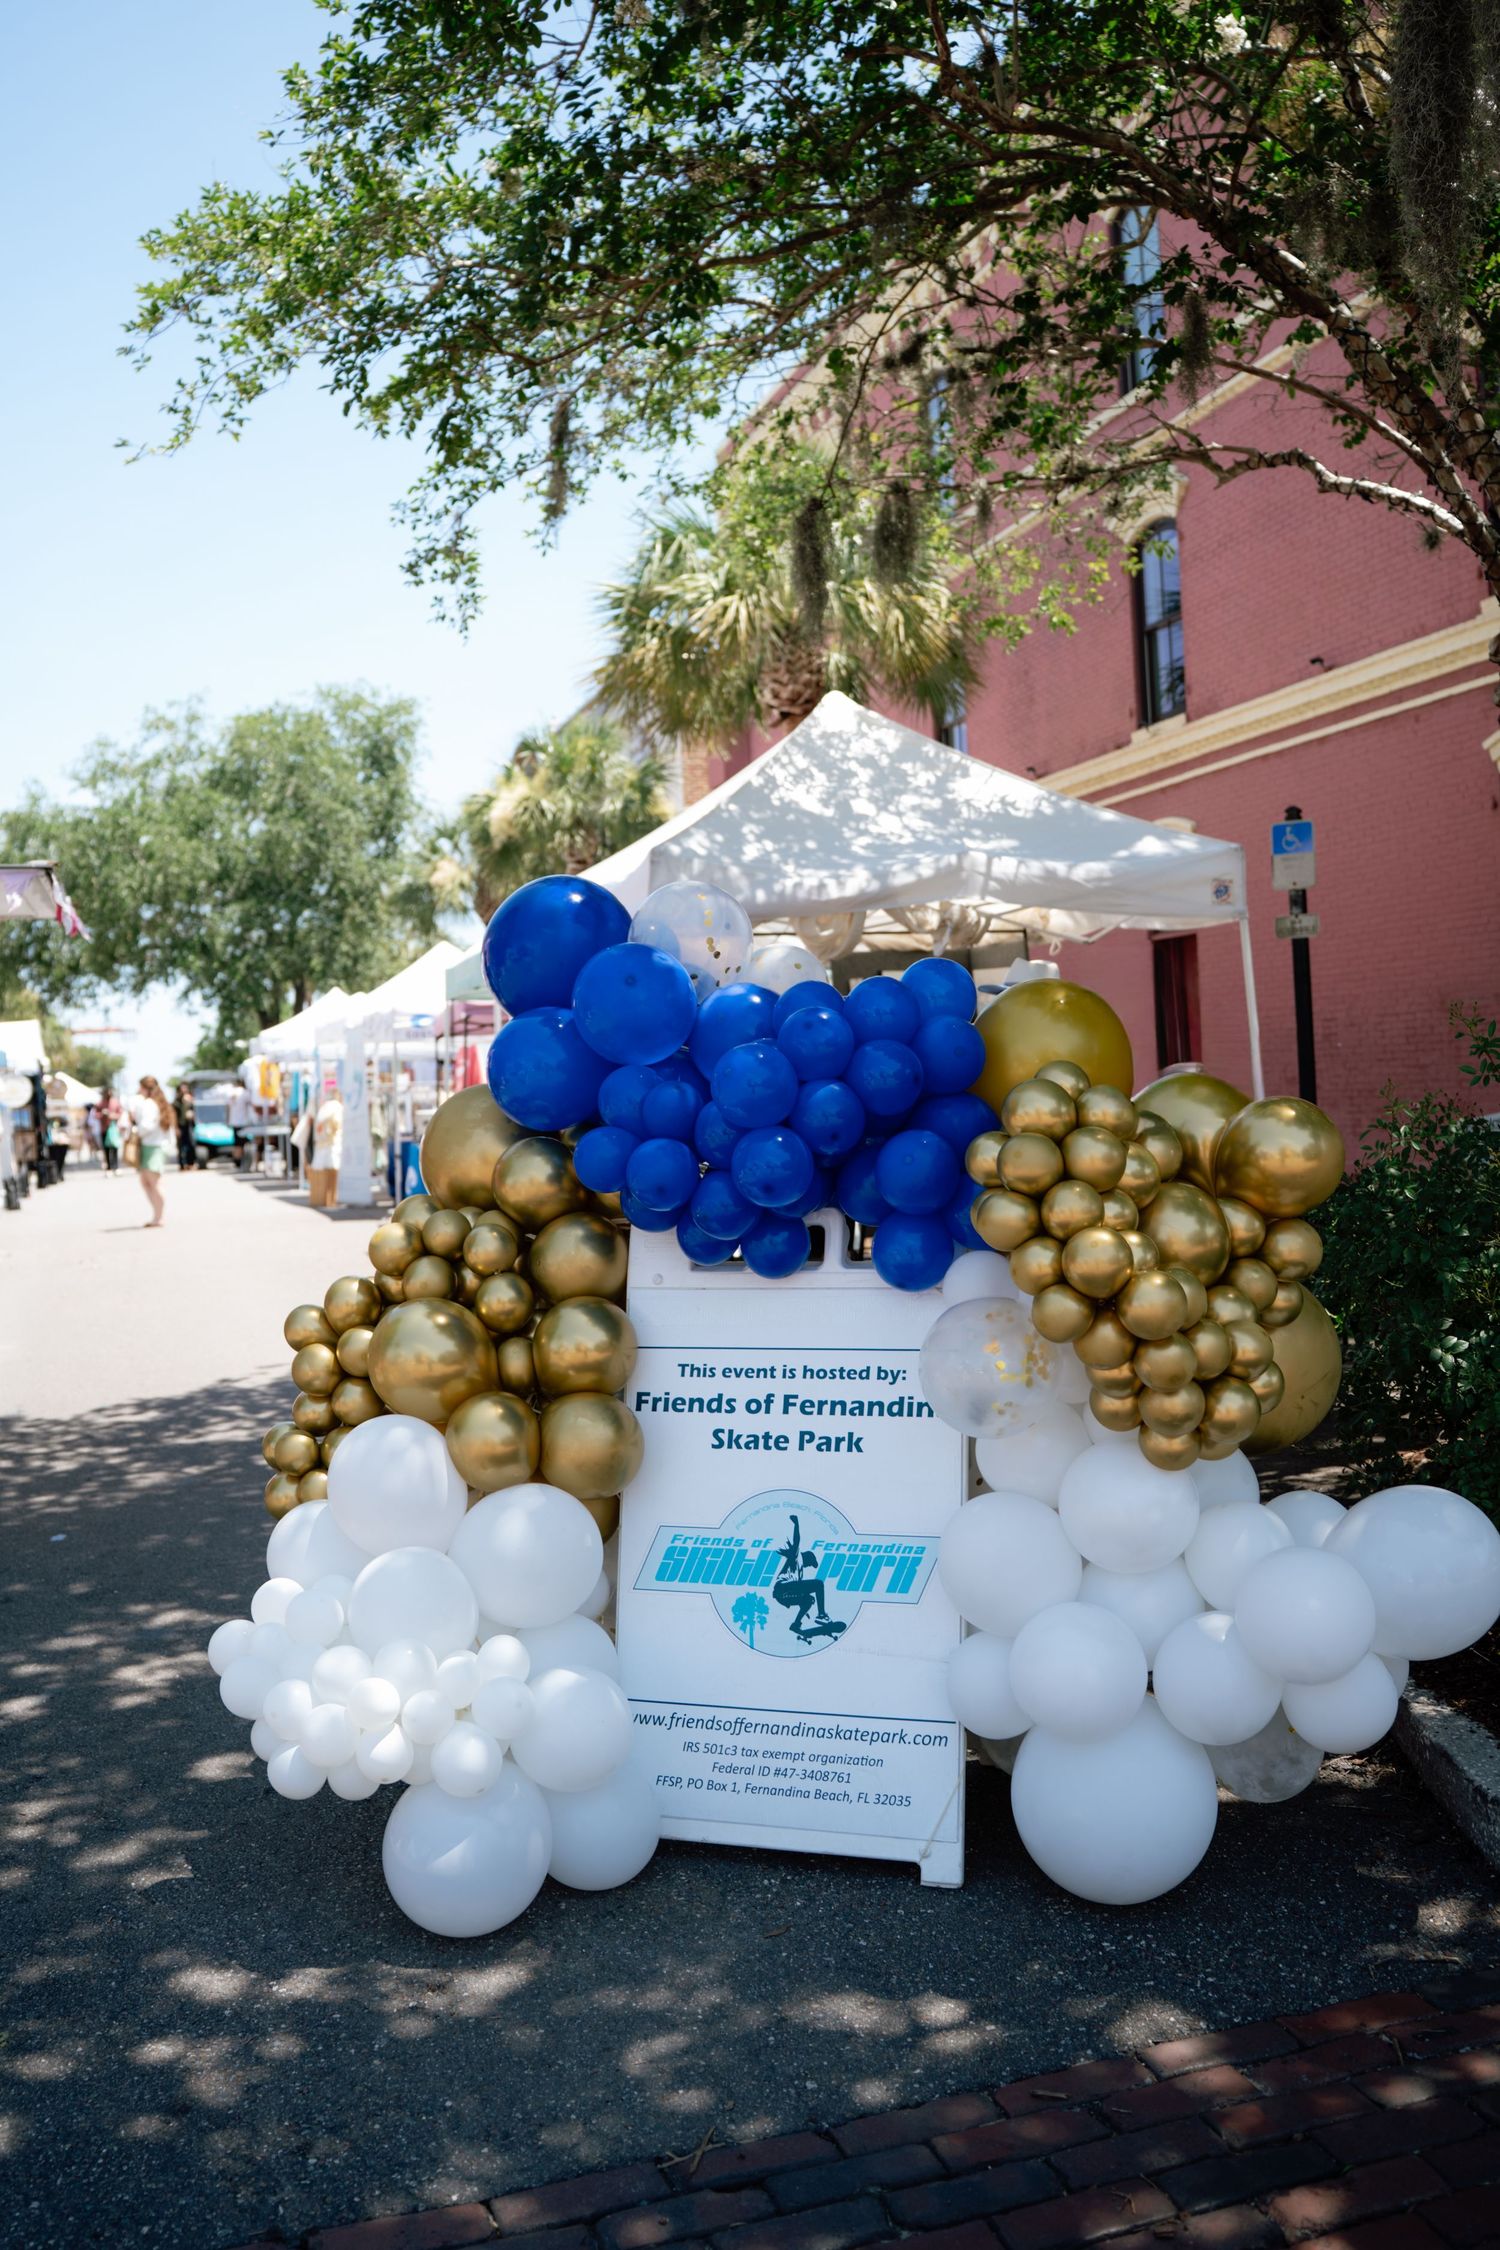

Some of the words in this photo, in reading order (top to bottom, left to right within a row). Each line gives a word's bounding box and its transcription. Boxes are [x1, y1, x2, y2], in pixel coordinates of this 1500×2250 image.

[677, 1363, 716, 1378] This
[721, 1365, 776, 1379] event
[782, 1365, 797, 1379] is
[802, 1365, 870, 1381] hosted
[876, 1367, 907, 1385] by:
[635, 1392, 737, 1414] Friends
[745, 1394, 774, 1414] of
[782, 1394, 934, 1417] Fernandin
[711, 1428, 789, 1451] Skate
[798, 1431, 864, 1452] Park
[670, 1534, 744, 1547] Friends
[751, 1538, 773, 1548] of
[811, 1540, 926, 1554] Fernandina
[682, 1741, 700, 1753] IRS
[702, 1742, 738, 1756] 501c3
[741, 1745, 759, 1758] tax
[762, 1748, 805, 1763] exempt
[808, 1751, 884, 1768] organization
[712, 1762, 755, 1776] Federal
[757, 1765, 770, 1777] ID
[773, 1765, 851, 1784] #47-3408761
[656, 1775, 683, 1790] FFSP,
[687, 1777, 703, 1789] PO
[706, 1779, 728, 1792] Box
[731, 1782, 740, 1795] 1,
[744, 1783, 811, 1799] Fernandina
[814, 1789, 853, 1804] Beach,
[857, 1793, 870, 1804] FL
[873, 1793, 911, 1807] 32035
